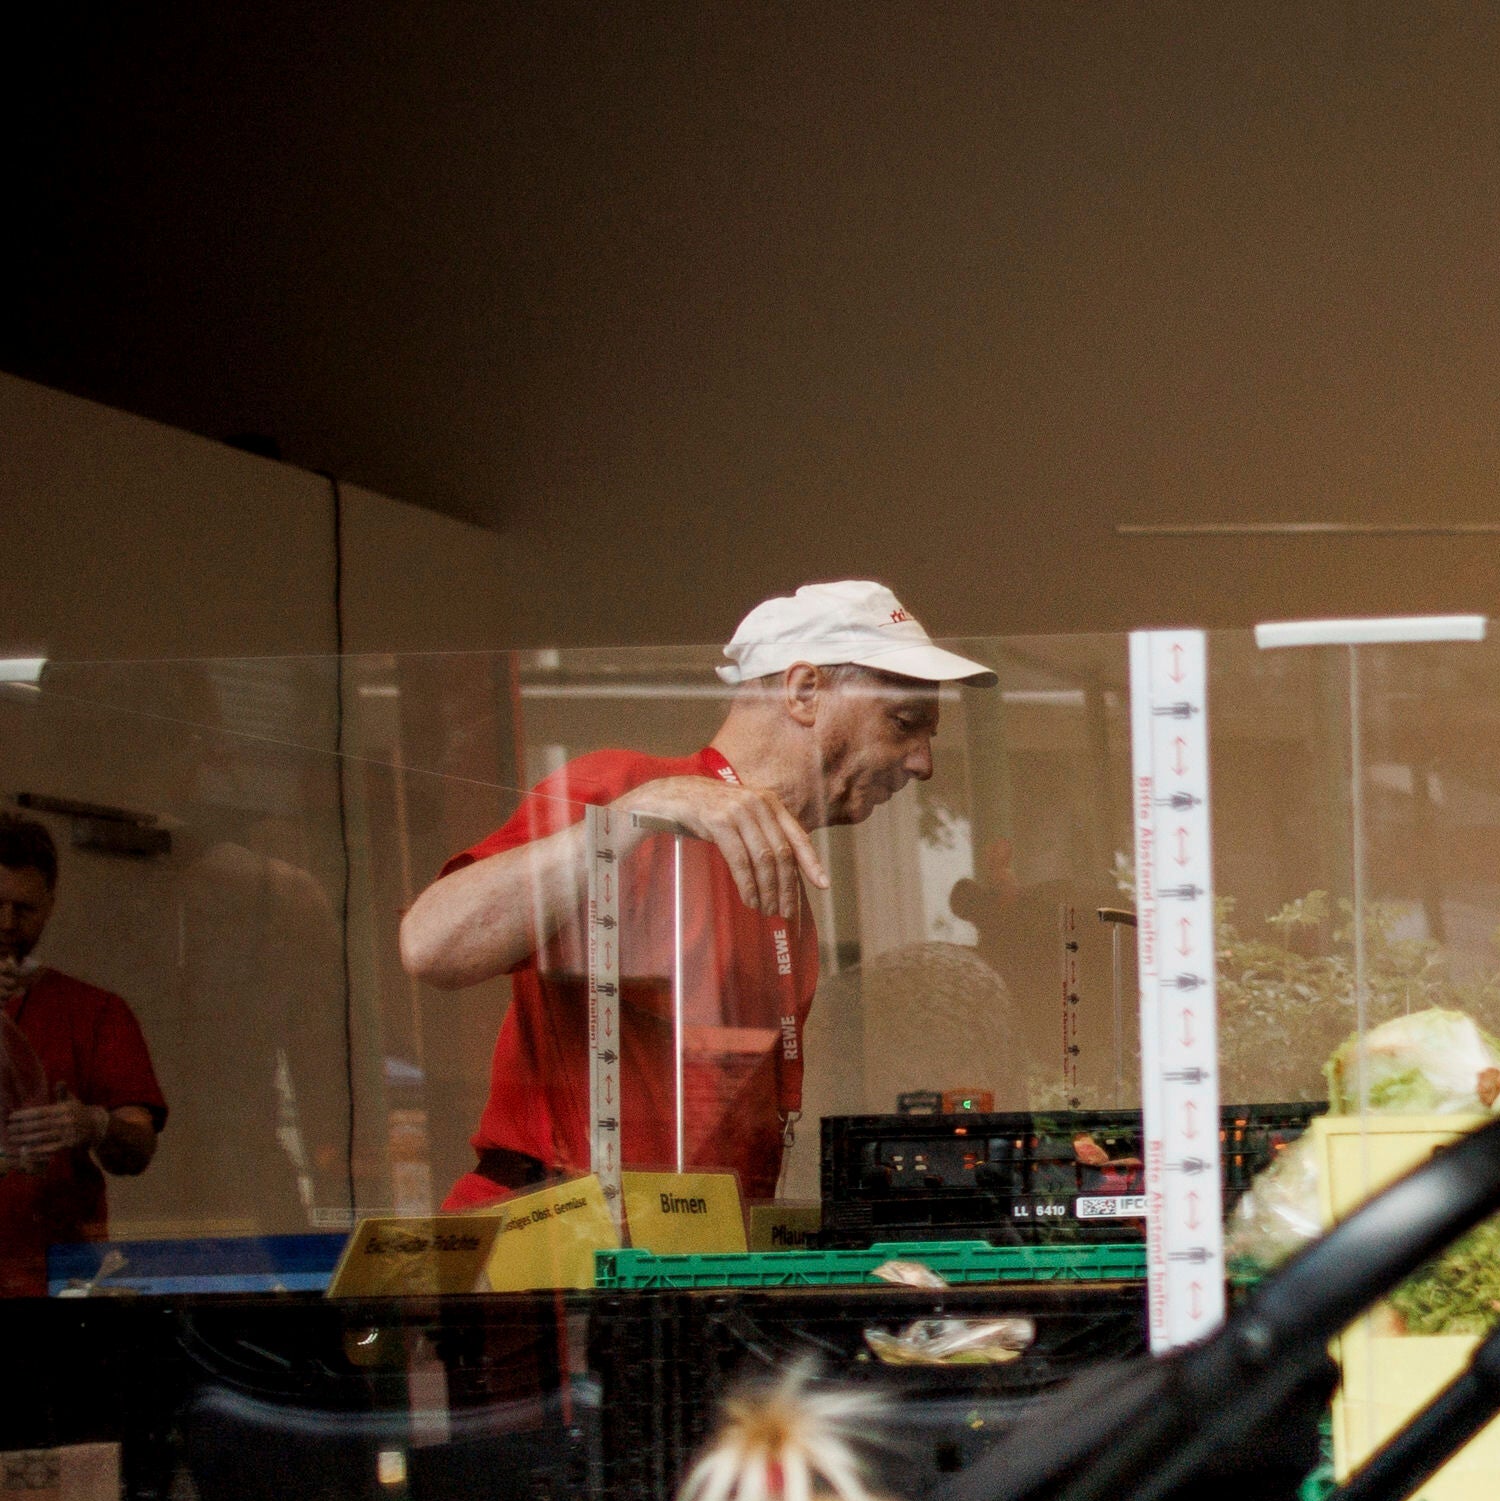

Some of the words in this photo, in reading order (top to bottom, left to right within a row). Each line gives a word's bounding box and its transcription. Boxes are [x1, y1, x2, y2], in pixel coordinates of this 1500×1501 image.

[1139, 776, 1152, 820] Bitte
[1140, 827, 1155, 901] Abstand
[773, 928, 792, 975] REWE
[1143, 908, 1157, 965] halten
[780, 1015, 799, 1060] REWE
[504, 1213, 532, 1232] stiges
[659, 1192, 708, 1214] Birnen
[1014, 1206, 1029, 1217] LL
[1036, 1205, 1066, 1217] 6410
[771, 1225, 808, 1246] Pflau
[1150, 1192, 1165, 1265] Abstand
[1151, 1272, 1168, 1328] halten
